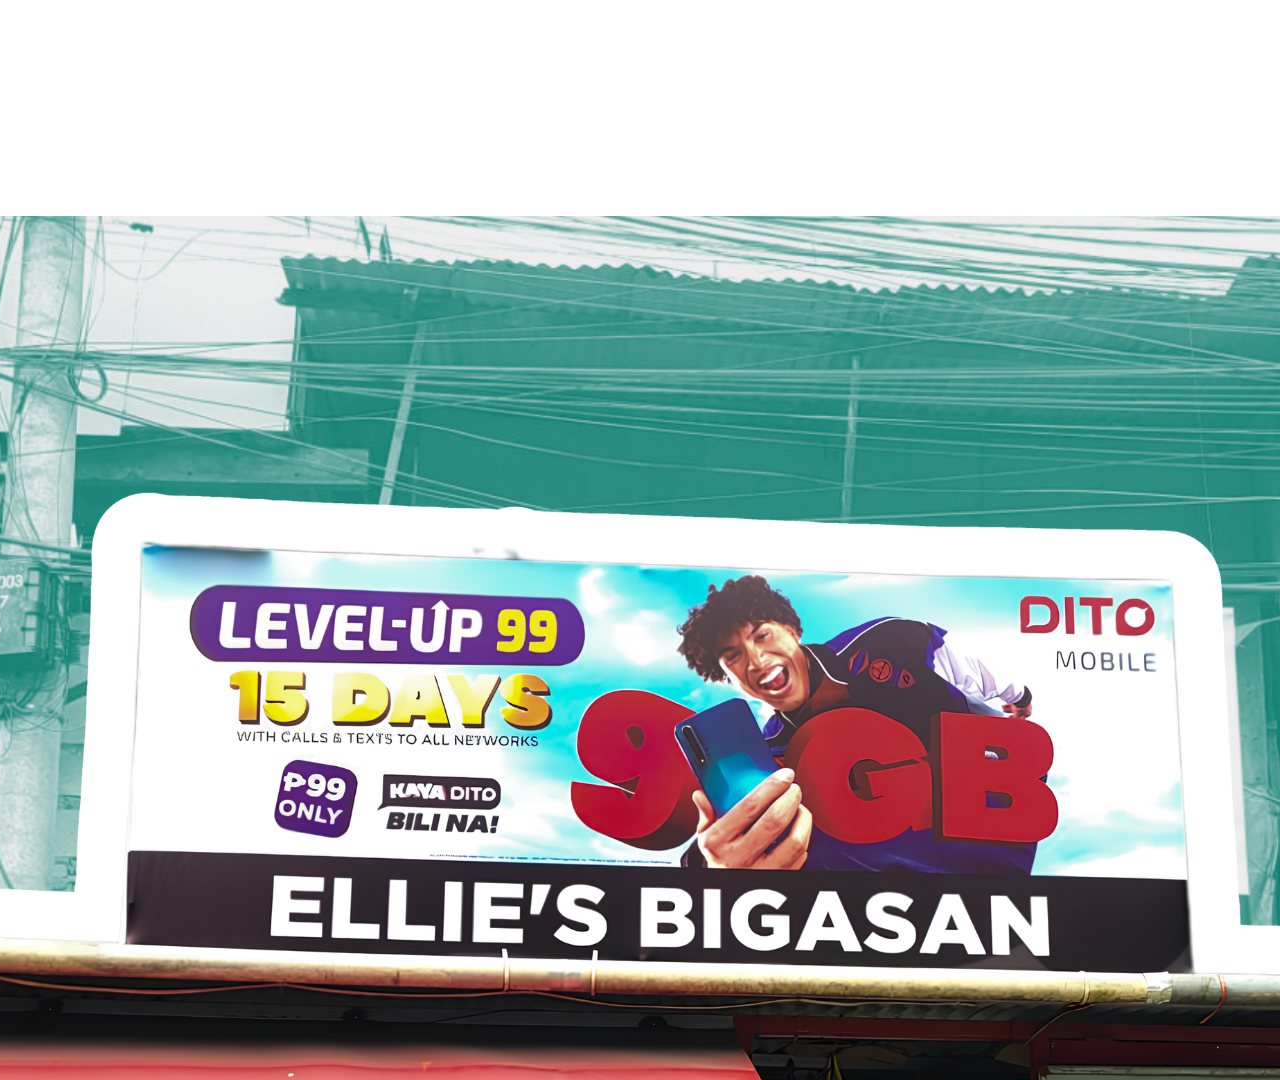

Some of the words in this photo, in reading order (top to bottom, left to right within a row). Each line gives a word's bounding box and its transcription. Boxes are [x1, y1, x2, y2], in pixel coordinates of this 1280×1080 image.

[1019, 595, 1156, 636] DITO
[496, 609, 558, 654] 99
[1055, 650, 1157, 673] MOBILE
[229, 670, 310, 727] 15
[332, 673, 553, 731] DAYS
[237, 731, 276, 743] WITH
[281, 731, 329, 744] CALLS
[347, 732, 393, 745] TEXTS
[397, 733, 418, 745] TO
[421, 734, 450, 746] ALL
[454, 734, 539, 747] NETWORKS
[389, 783, 447, 801] KAYA
[450, 785, 498, 802] DITO
[278, 799, 344, 825] ONLY
[386, 811, 442, 831] BILI
[445, 813, 500, 834] NA!
[270, 874, 608, 947] ELLIE'S
[639, 886, 1051, 957] BIGASAN
